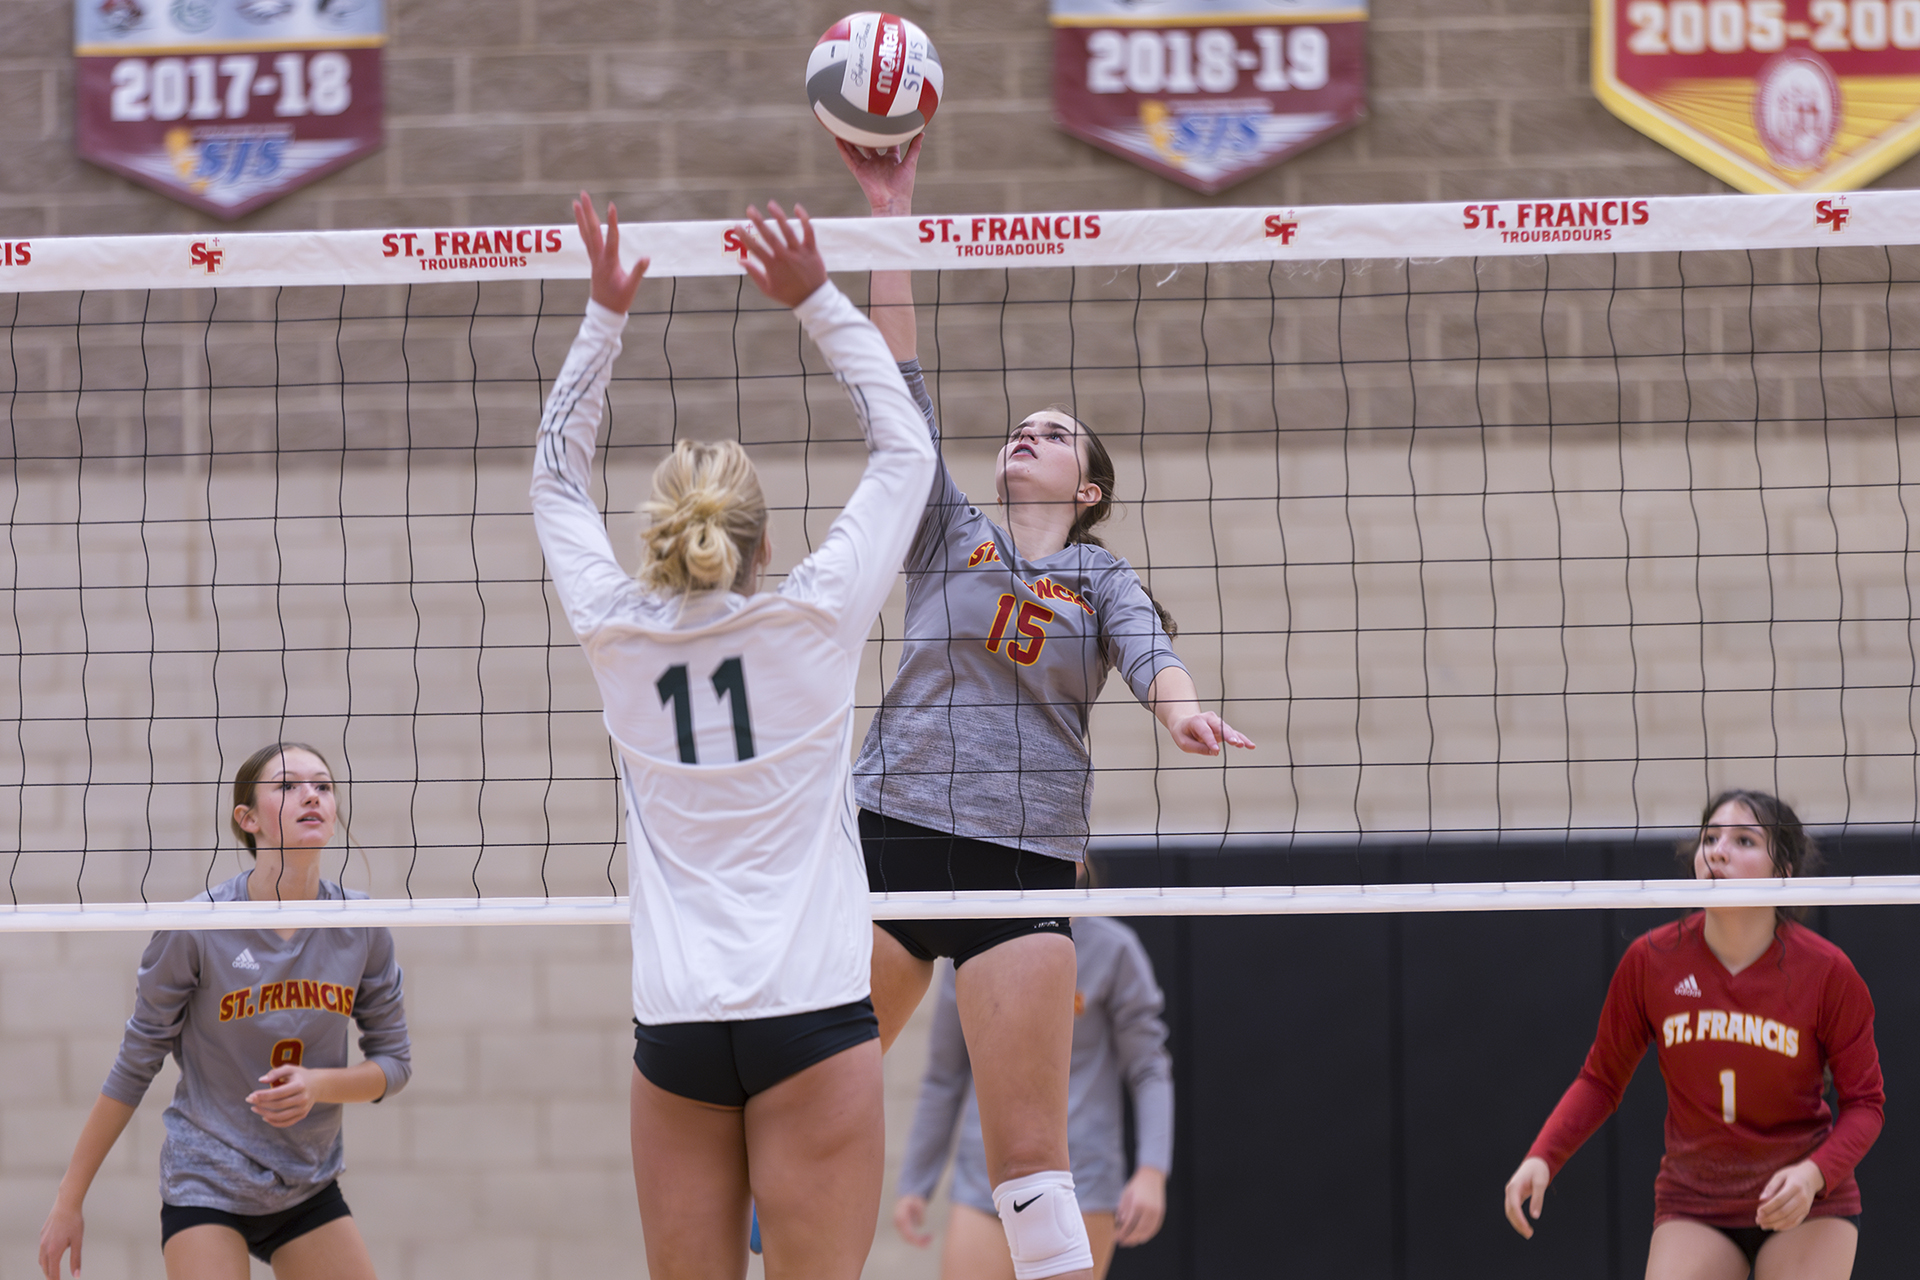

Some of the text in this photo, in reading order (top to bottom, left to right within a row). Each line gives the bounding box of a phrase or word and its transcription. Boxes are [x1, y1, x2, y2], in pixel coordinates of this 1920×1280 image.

[876, 22, 900, 94] molten
[1086, 26, 1330, 94] 2018-19
[110, 51, 352, 122] 2017-18
[918, 215, 1102, 243] ST. FRANCIS
[1264, 213, 1298, 246] SF
[1463, 200, 1650, 230] ST. FRANCIS
[1815, 199, 1850, 232] SF
[382, 229, 562, 257] ST. FRANCIS
[956, 242, 1065, 257] TROUBADOURS
[1501, 229, 1613, 243] TROUBADOURS
[189, 241, 224, 273] SF
[419, 256, 528, 271] TROUBADOURS
[985, 592, 1055, 667] 15
[655, 654, 757, 765] 11
[232, 959, 260, 970] adidas
[219, 979, 356, 1022] ST. FRANCIS
[1662, 1009, 1800, 1059] ST. FRANCIS
[1719, 1068, 1736, 1125] 1
